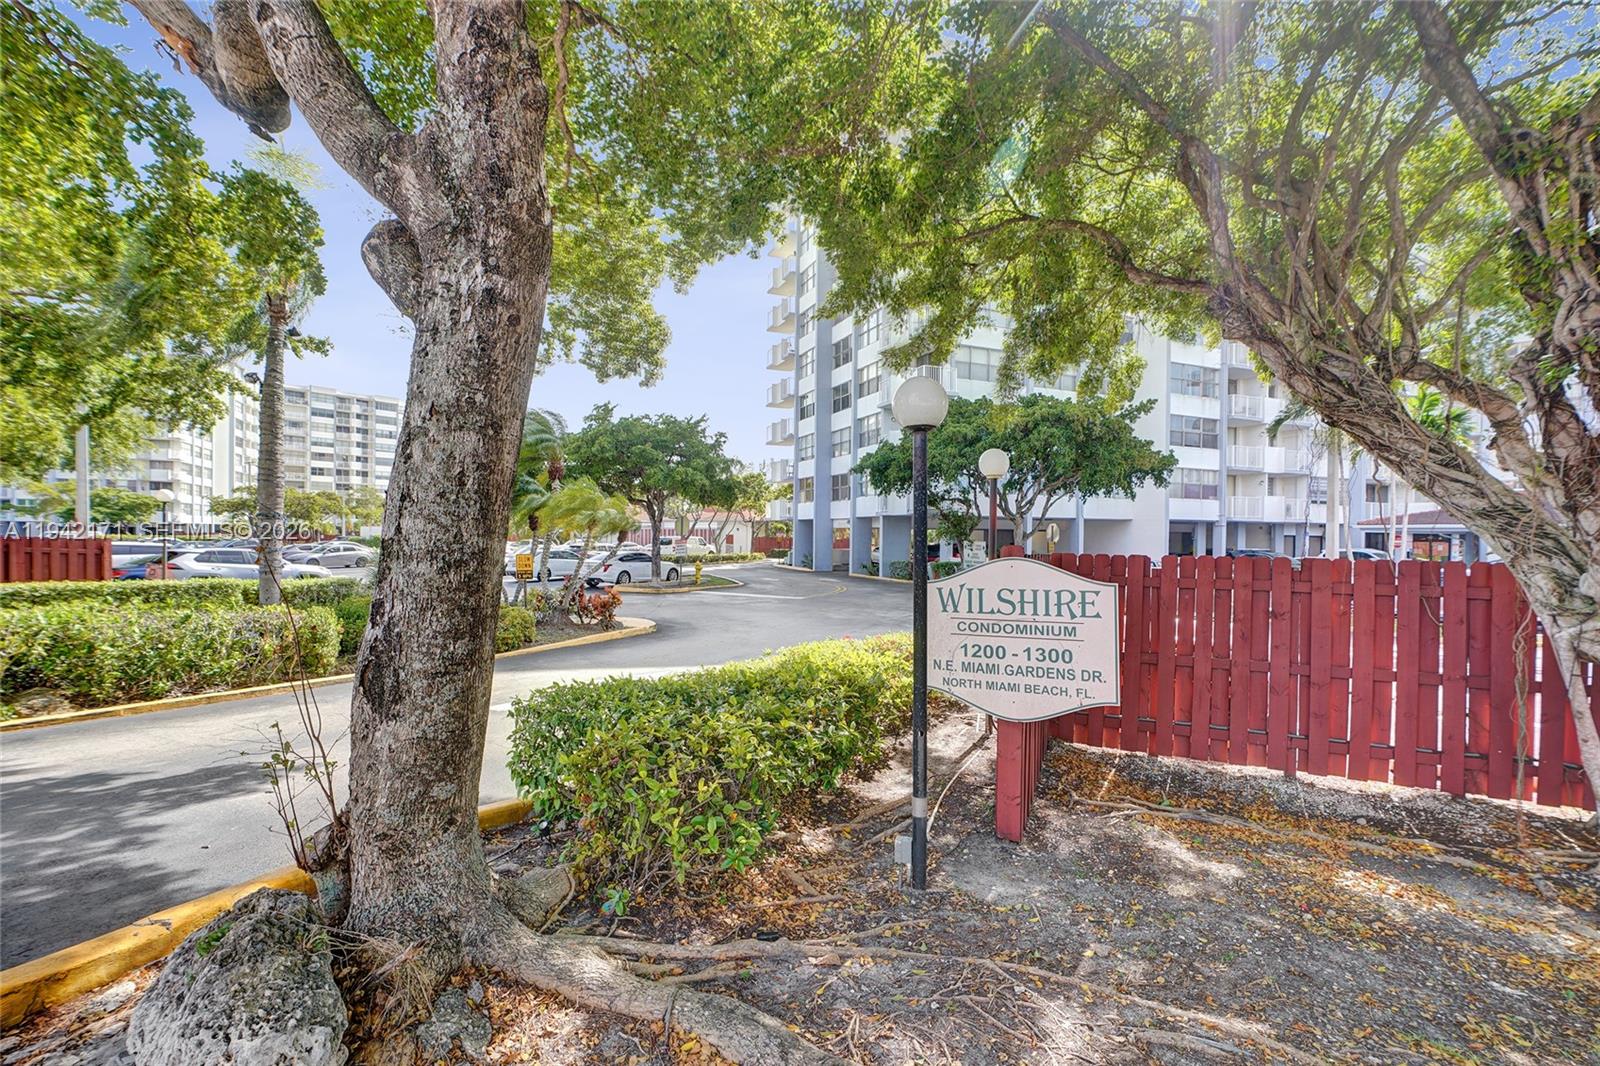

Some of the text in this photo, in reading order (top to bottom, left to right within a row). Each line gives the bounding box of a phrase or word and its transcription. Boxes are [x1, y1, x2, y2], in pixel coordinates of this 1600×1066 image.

[936, 583, 1102, 620] WILSHIRE
[957, 621, 1077, 638] CONDOMINIUM
[960, 643, 1007, 660] 1200
[1022, 646, 1073, 664] 1300
[933, 659, 1107, 684] N.E. MIAMI GARDENS DR.
[942, 676, 1096, 700] NORTH MIAMI BEACH, FL.
